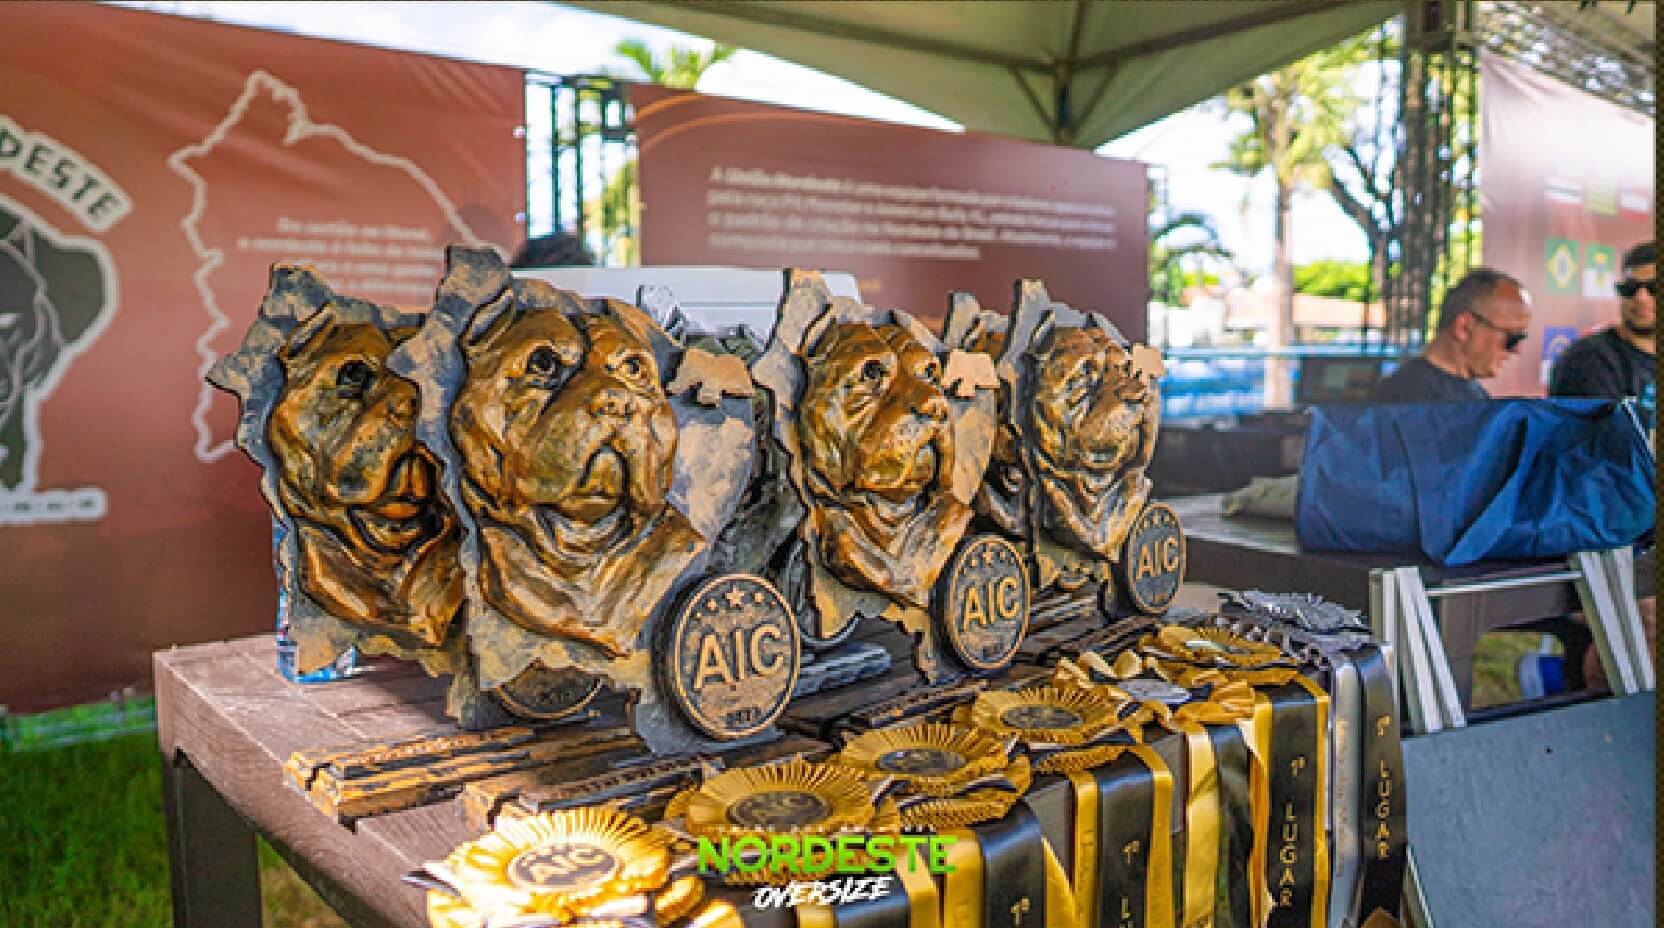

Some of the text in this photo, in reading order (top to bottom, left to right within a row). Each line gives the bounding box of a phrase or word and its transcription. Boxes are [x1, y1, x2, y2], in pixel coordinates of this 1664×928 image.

[1136, 536, 1179, 580] AIC
[963, 576, 1018, 633] AIC
[693, 625, 784, 690] AIC
